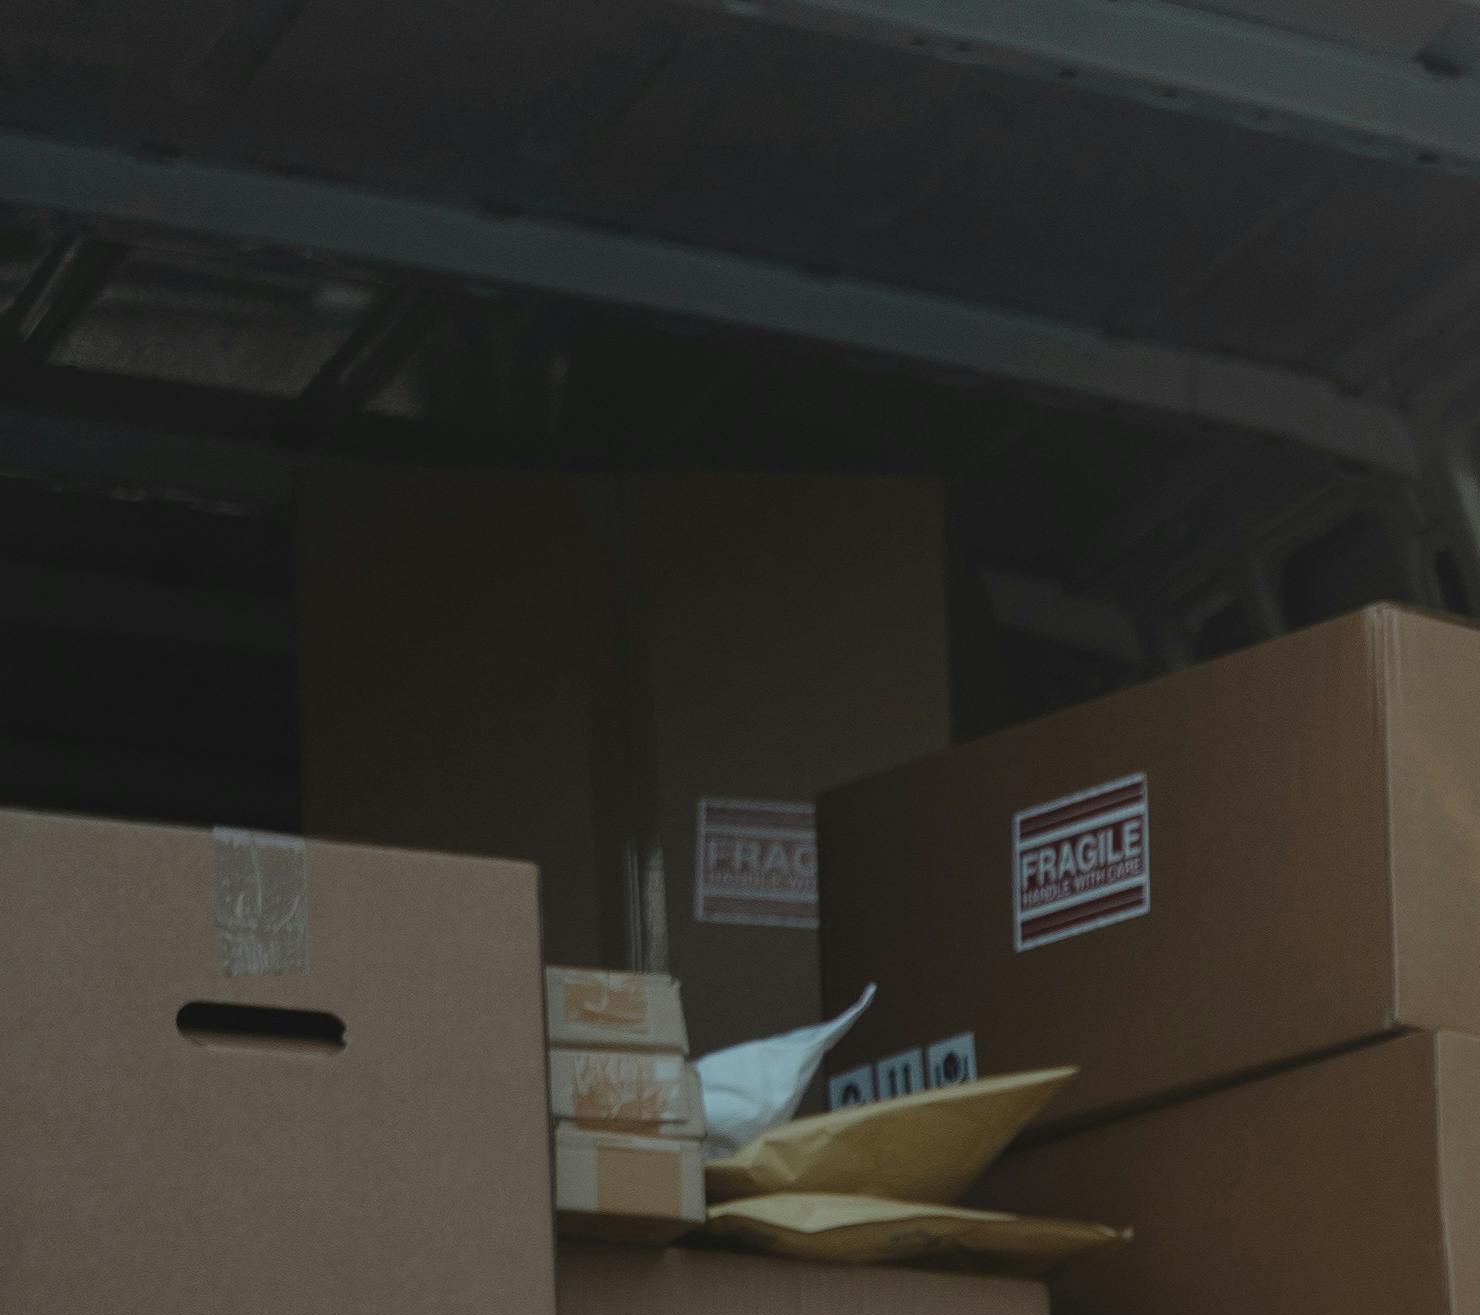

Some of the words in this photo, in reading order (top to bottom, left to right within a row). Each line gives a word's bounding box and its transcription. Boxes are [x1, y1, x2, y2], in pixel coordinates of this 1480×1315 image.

[706, 839, 817, 877] FRAG
[1021, 820, 1142, 890] FRAGILE
[1022, 880, 1071, 907] HANDLE
[1074, 867, 1105, 892] WITH
[1106, 857, 1143, 883] CARE
